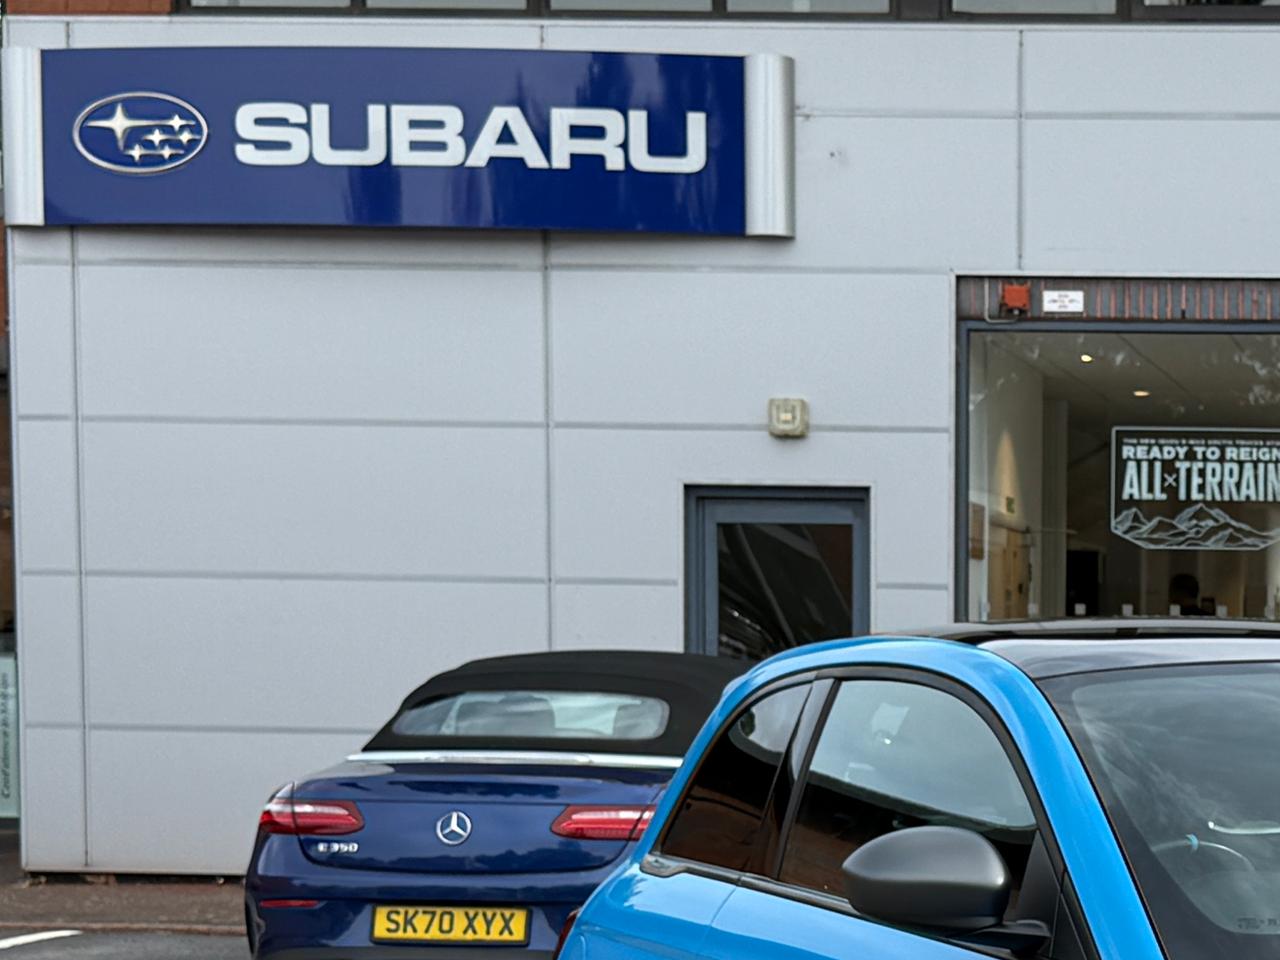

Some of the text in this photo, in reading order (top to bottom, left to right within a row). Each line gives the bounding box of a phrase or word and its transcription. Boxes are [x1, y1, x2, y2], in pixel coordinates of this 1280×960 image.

[235, 103, 706, 173] SUBARU
[1122, 446, 1188, 460] READY
[1193, 446, 1221, 461] TO
[318, 842, 359, 853] E 350
[386, 910, 516, 936] SK70 XYX
